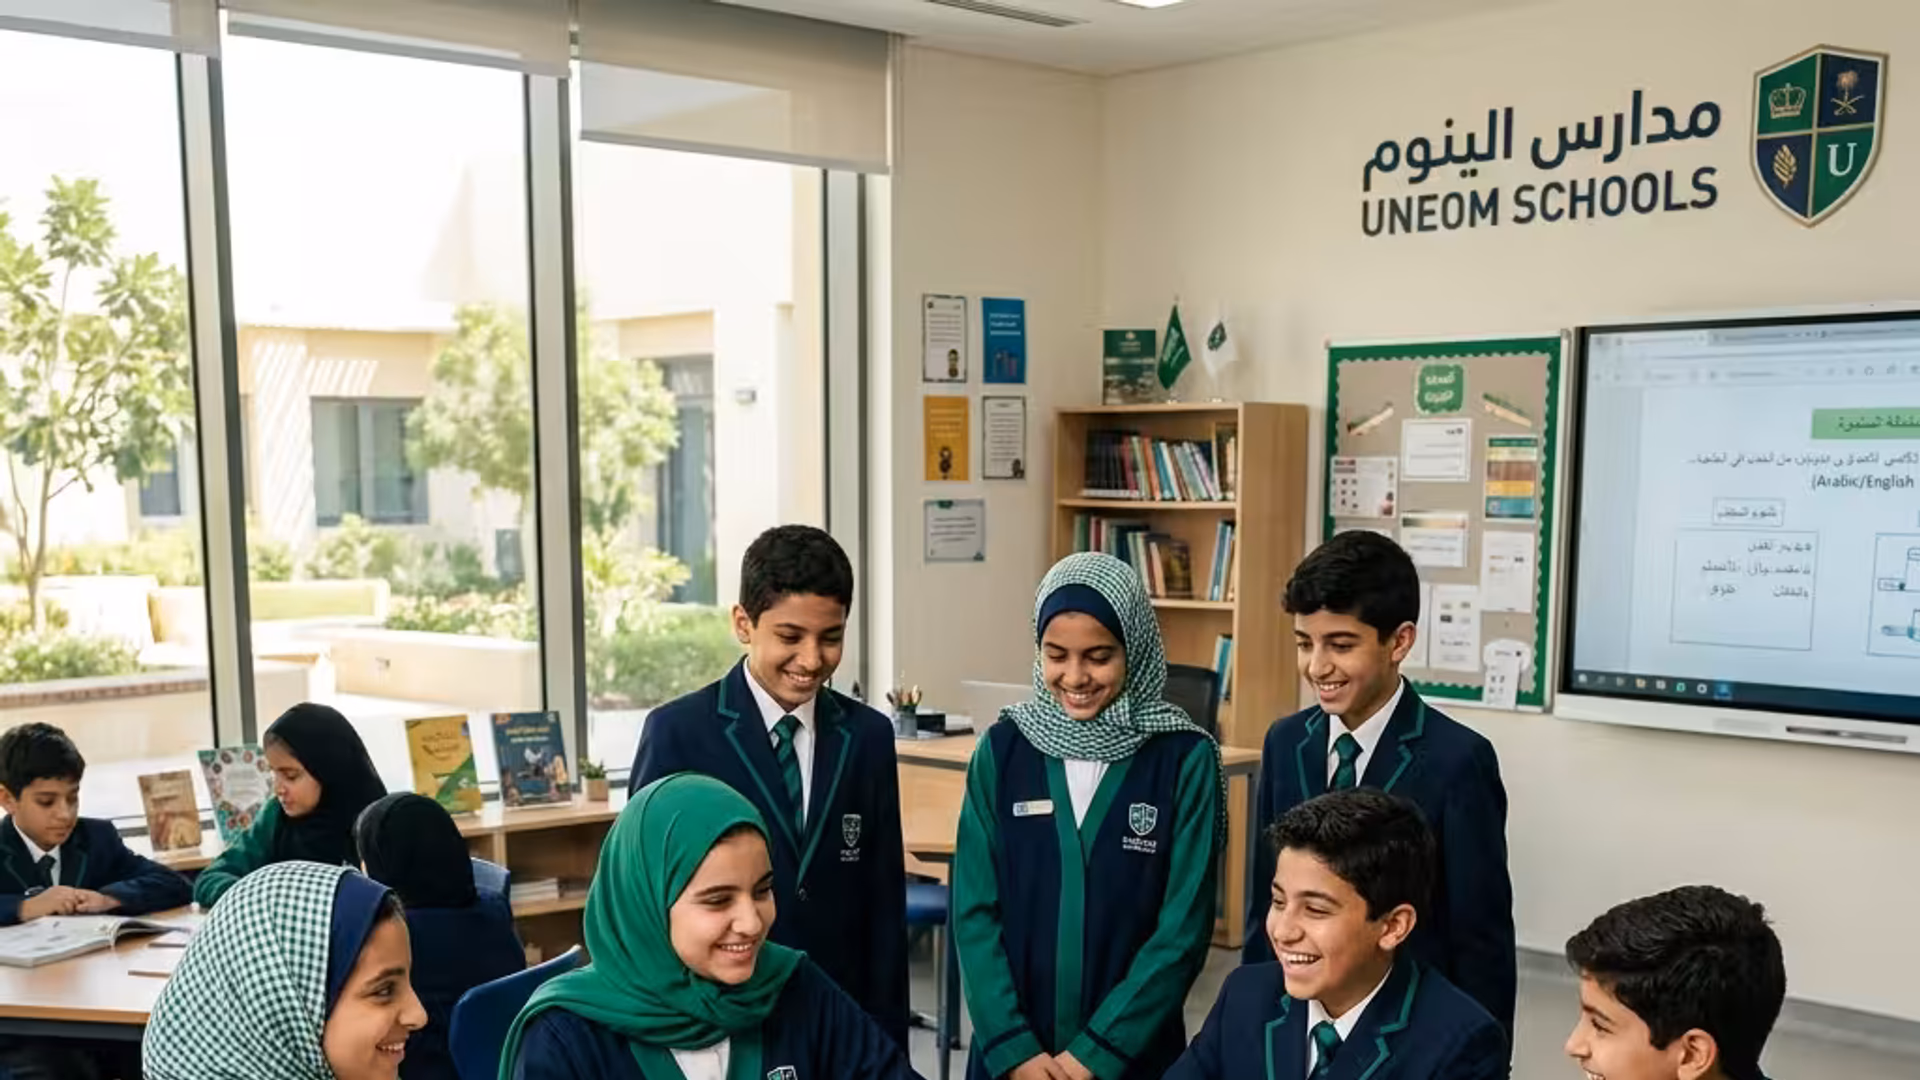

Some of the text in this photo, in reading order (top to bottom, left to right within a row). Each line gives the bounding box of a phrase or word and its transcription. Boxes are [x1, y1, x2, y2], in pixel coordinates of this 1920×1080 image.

[1362, 89, 1721, 193] مدارس الينوم
[1828, 143, 1857, 176] U
[1362, 166, 1718, 237] UNEOM SCHOOLS
